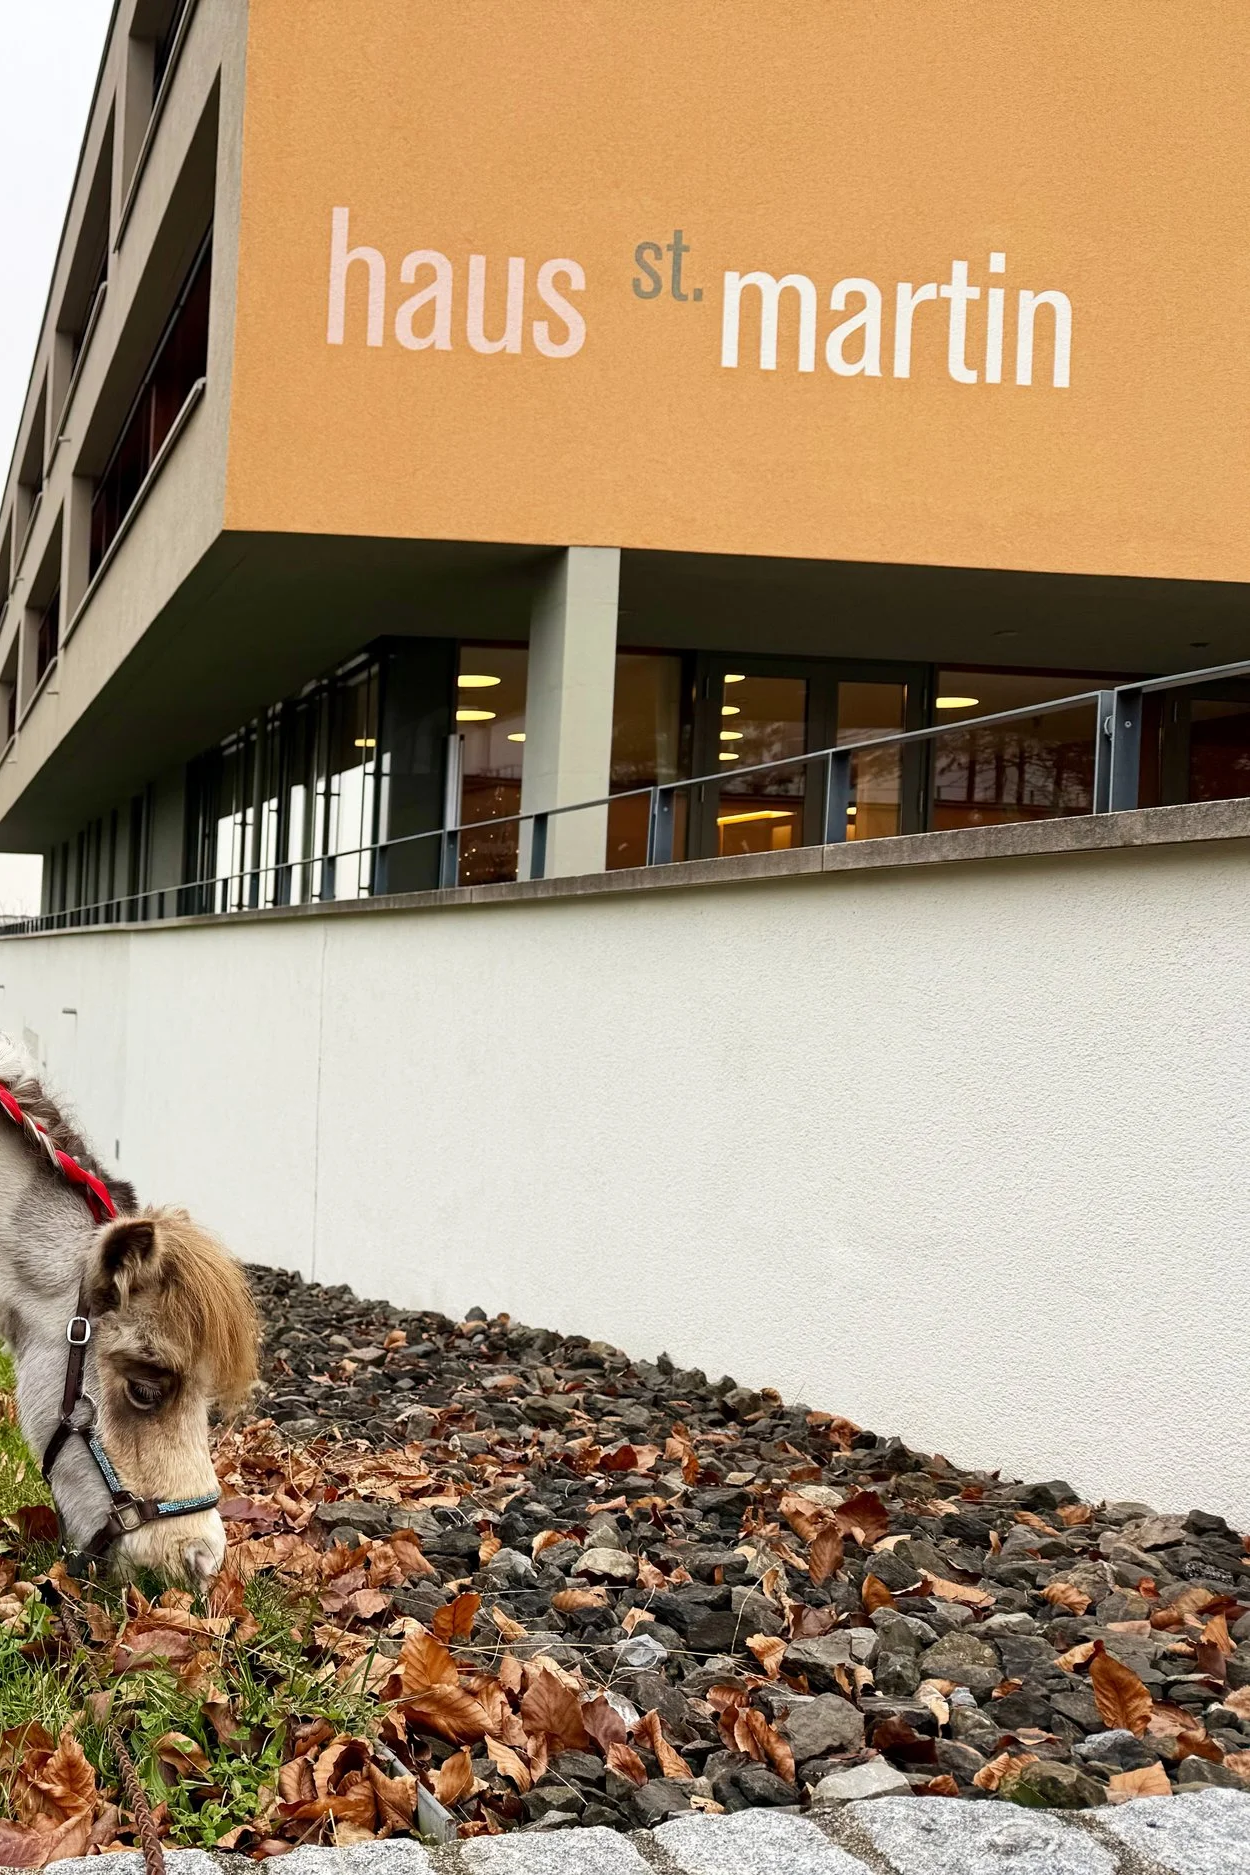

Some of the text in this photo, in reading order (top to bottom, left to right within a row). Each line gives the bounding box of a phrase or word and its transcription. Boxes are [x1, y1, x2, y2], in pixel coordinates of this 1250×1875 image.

[326, 206, 1073, 389] haus st. martin
